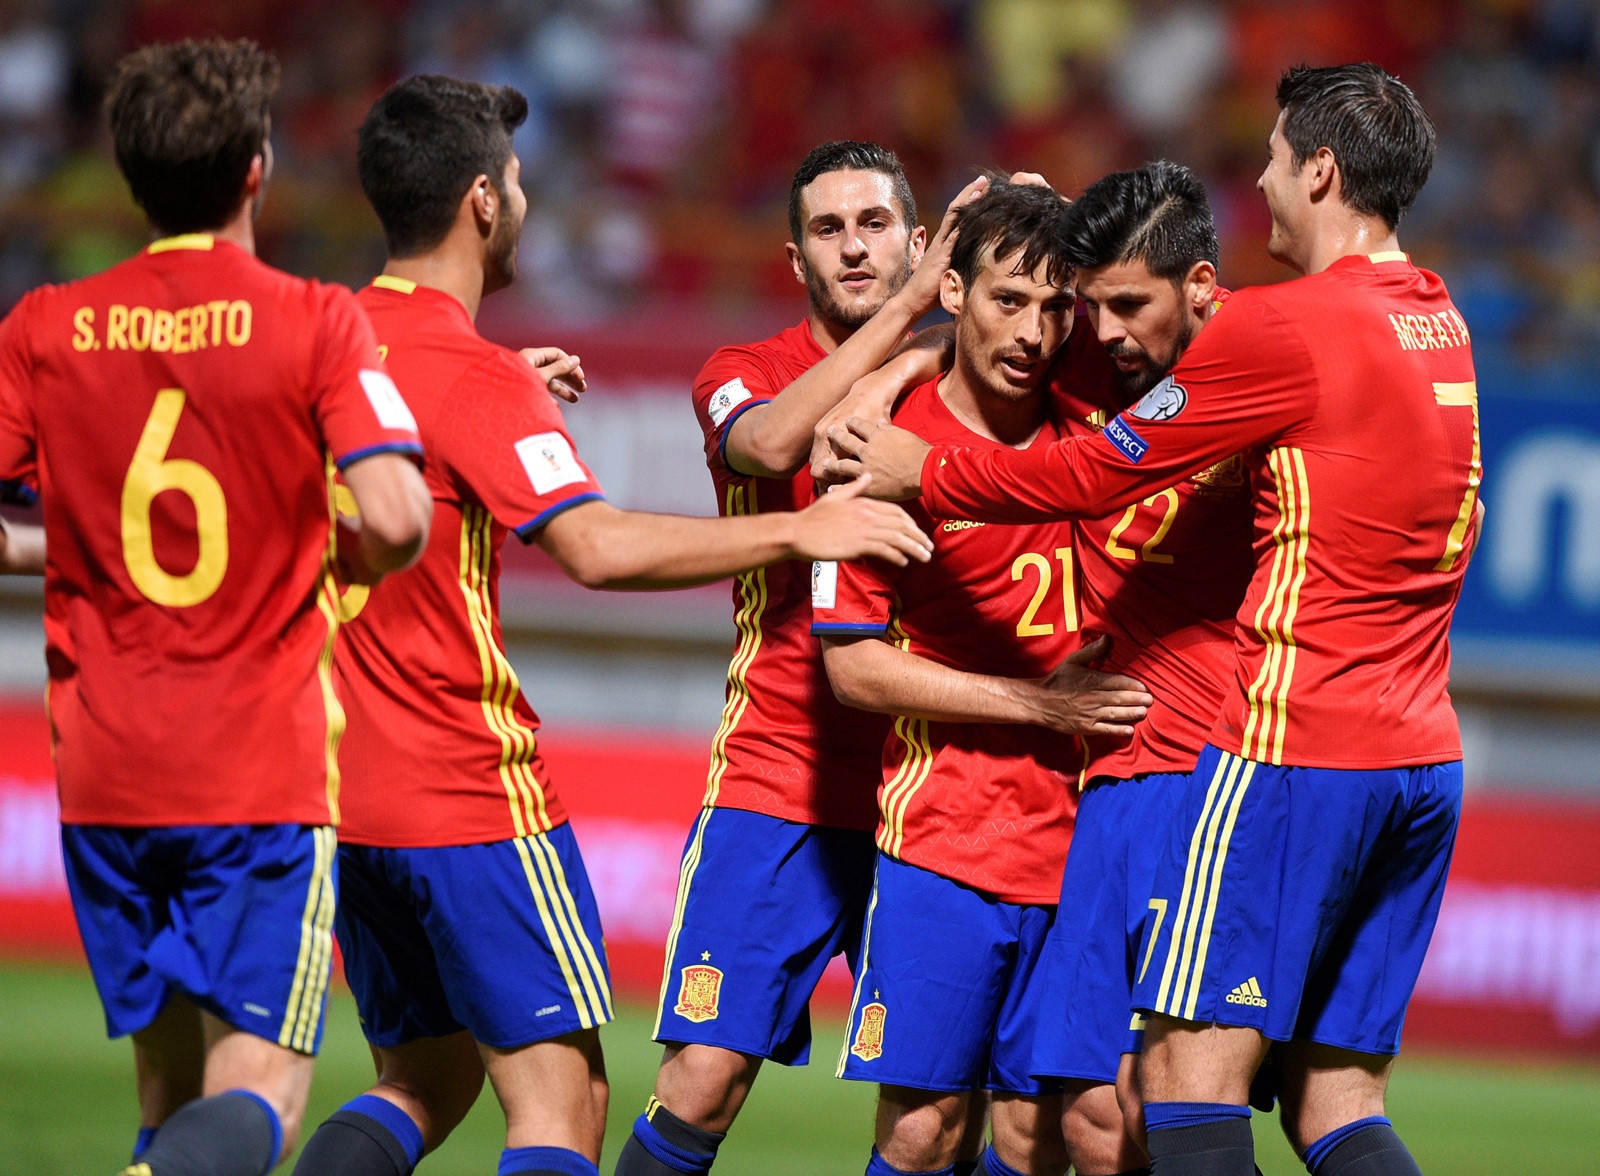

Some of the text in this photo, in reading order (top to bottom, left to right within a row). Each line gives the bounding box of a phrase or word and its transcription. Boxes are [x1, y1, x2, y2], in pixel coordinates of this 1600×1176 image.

[72, 299, 252, 354] S. ROBERTO
[1388, 308, 1471, 351] MORATA
[120, 387, 229, 608] 6
[1432, 380, 1479, 572] 7
[1105, 487, 1179, 564] 22
[1011, 547, 1078, 637] 21
[1137, 898, 1168, 985] 7
[1225, 993, 1268, 1008] adidas
